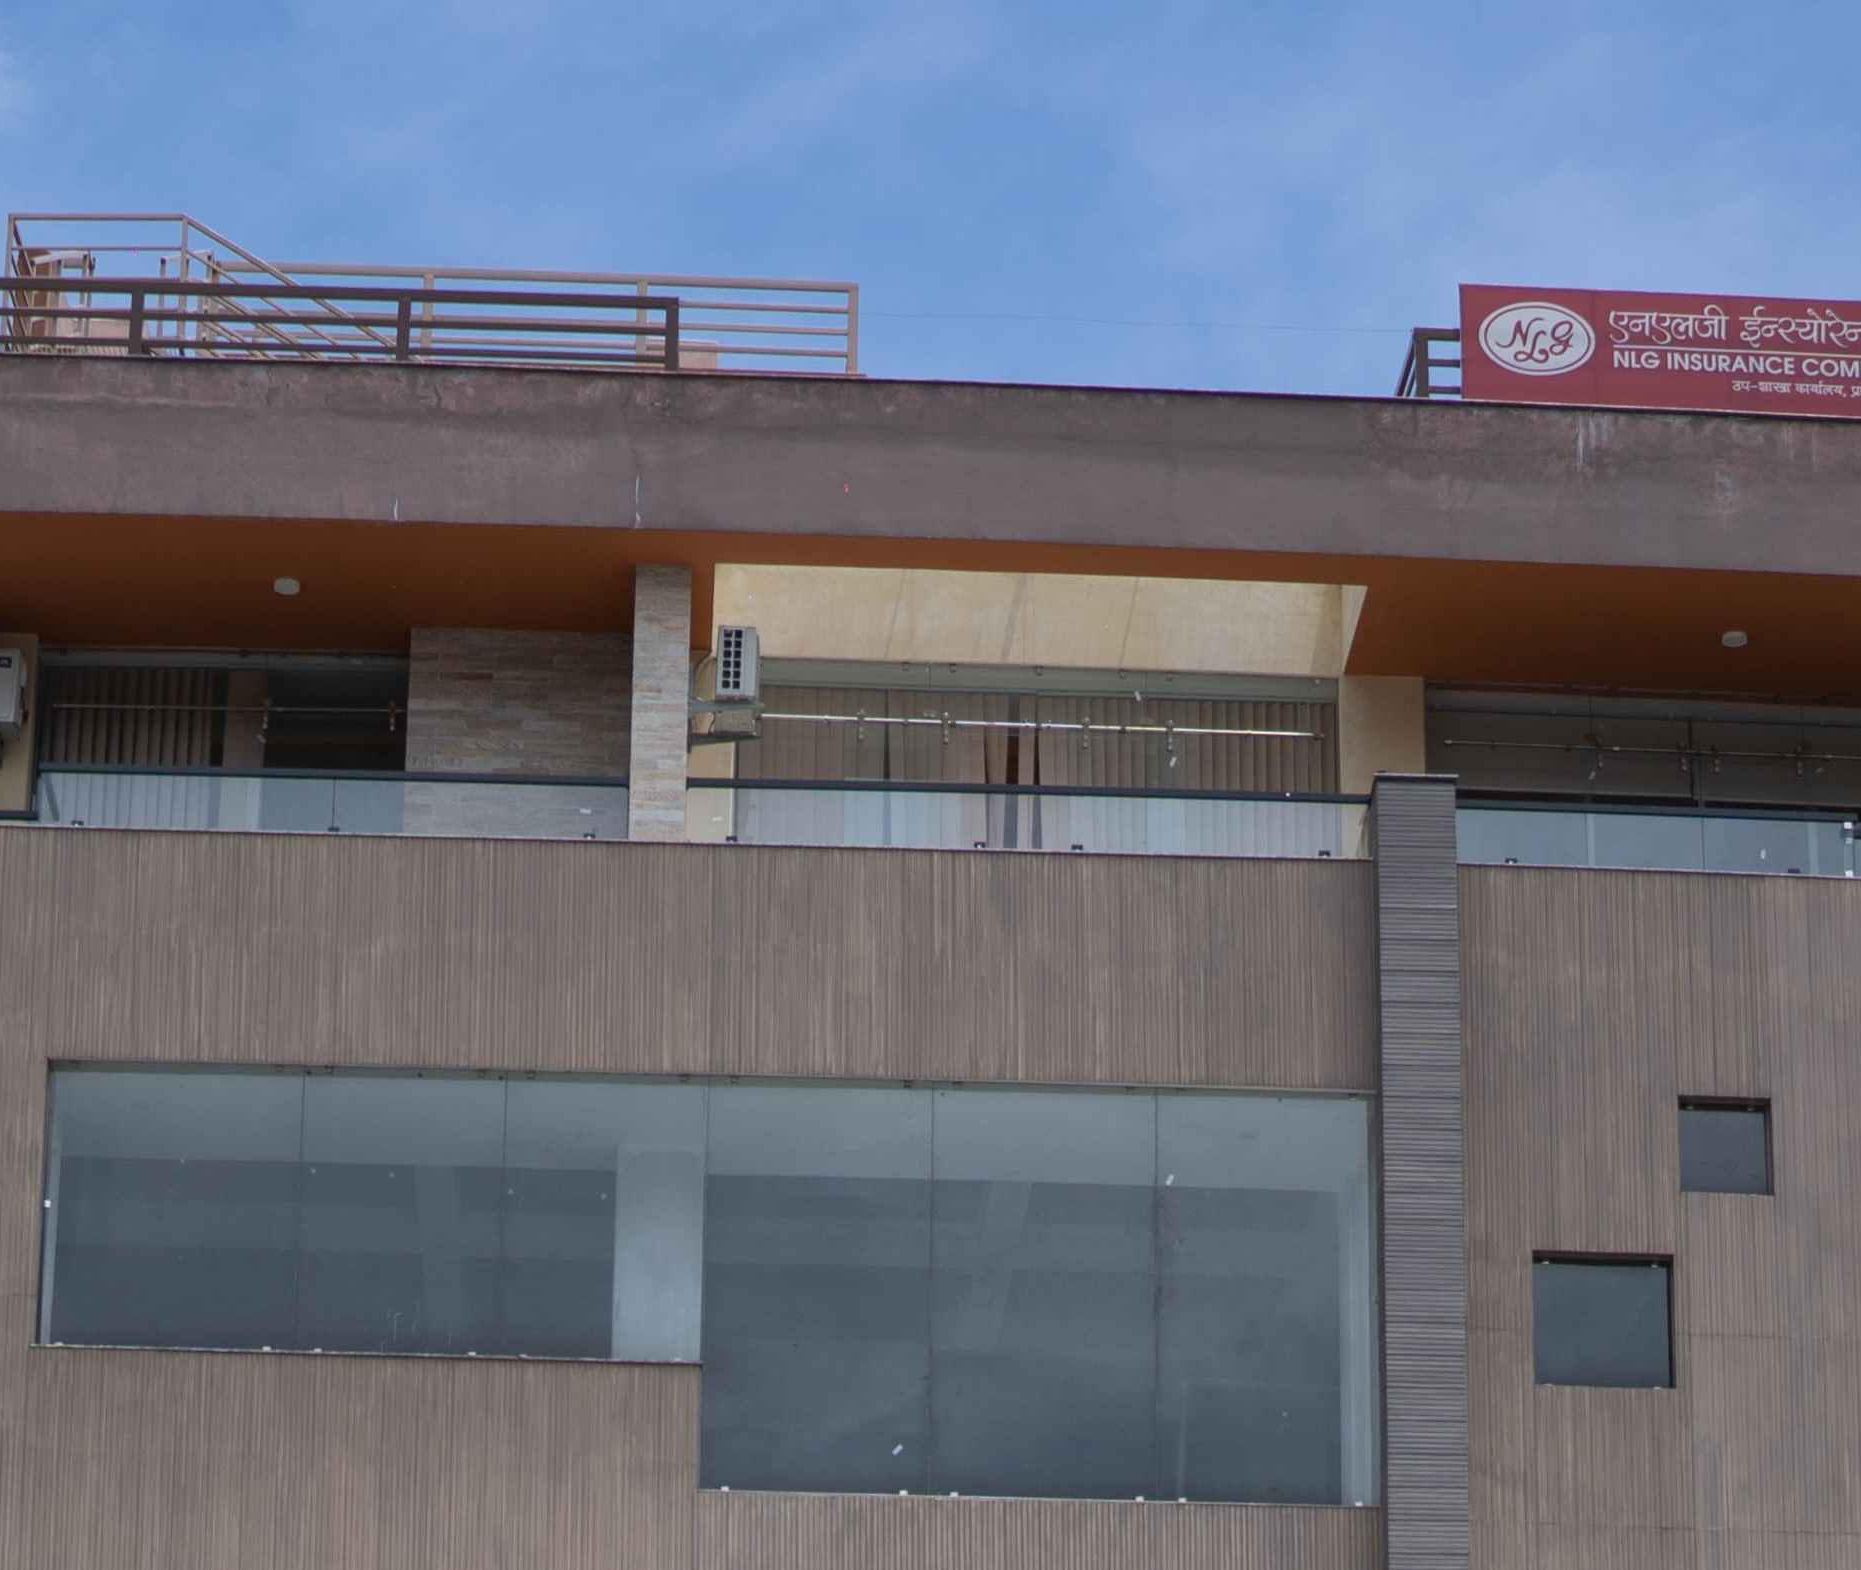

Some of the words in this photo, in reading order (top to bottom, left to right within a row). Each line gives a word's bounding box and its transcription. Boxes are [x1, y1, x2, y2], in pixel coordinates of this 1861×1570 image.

[1609, 305, 1729, 344] एनएलजी
[1613, 351, 1660, 369] NLG
[1667, 352, 1795, 376] INSURANCE
